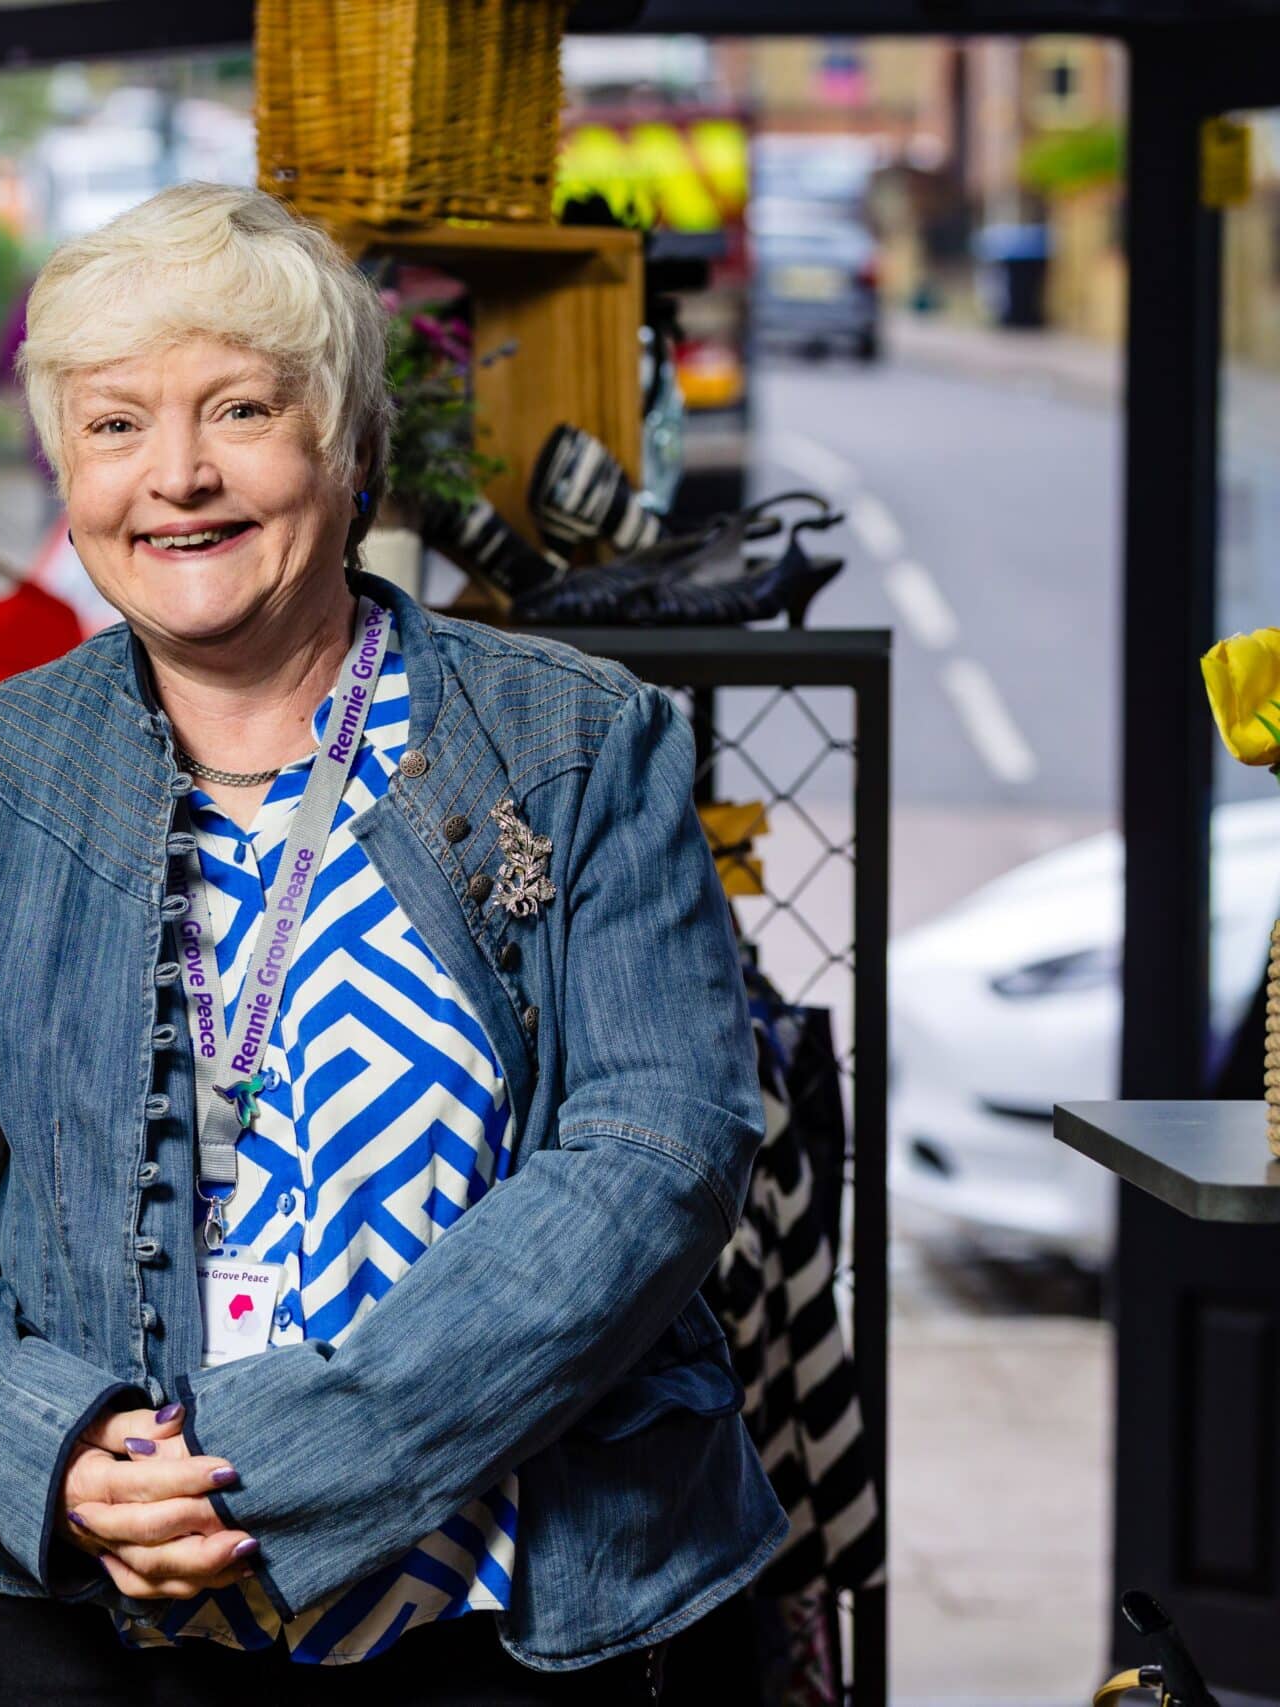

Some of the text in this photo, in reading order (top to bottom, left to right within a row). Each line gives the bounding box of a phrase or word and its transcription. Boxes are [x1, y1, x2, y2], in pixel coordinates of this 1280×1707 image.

[328, 604, 385, 765] Rennie Grove Pe
[179, 920, 205, 987] Grove
[193, 993, 216, 1058] Peace
[231, 848, 315, 1074] Rennie Grove Peace
[212, 1270, 239, 1281] Grove
[242, 1272, 269, 1283] Peace
